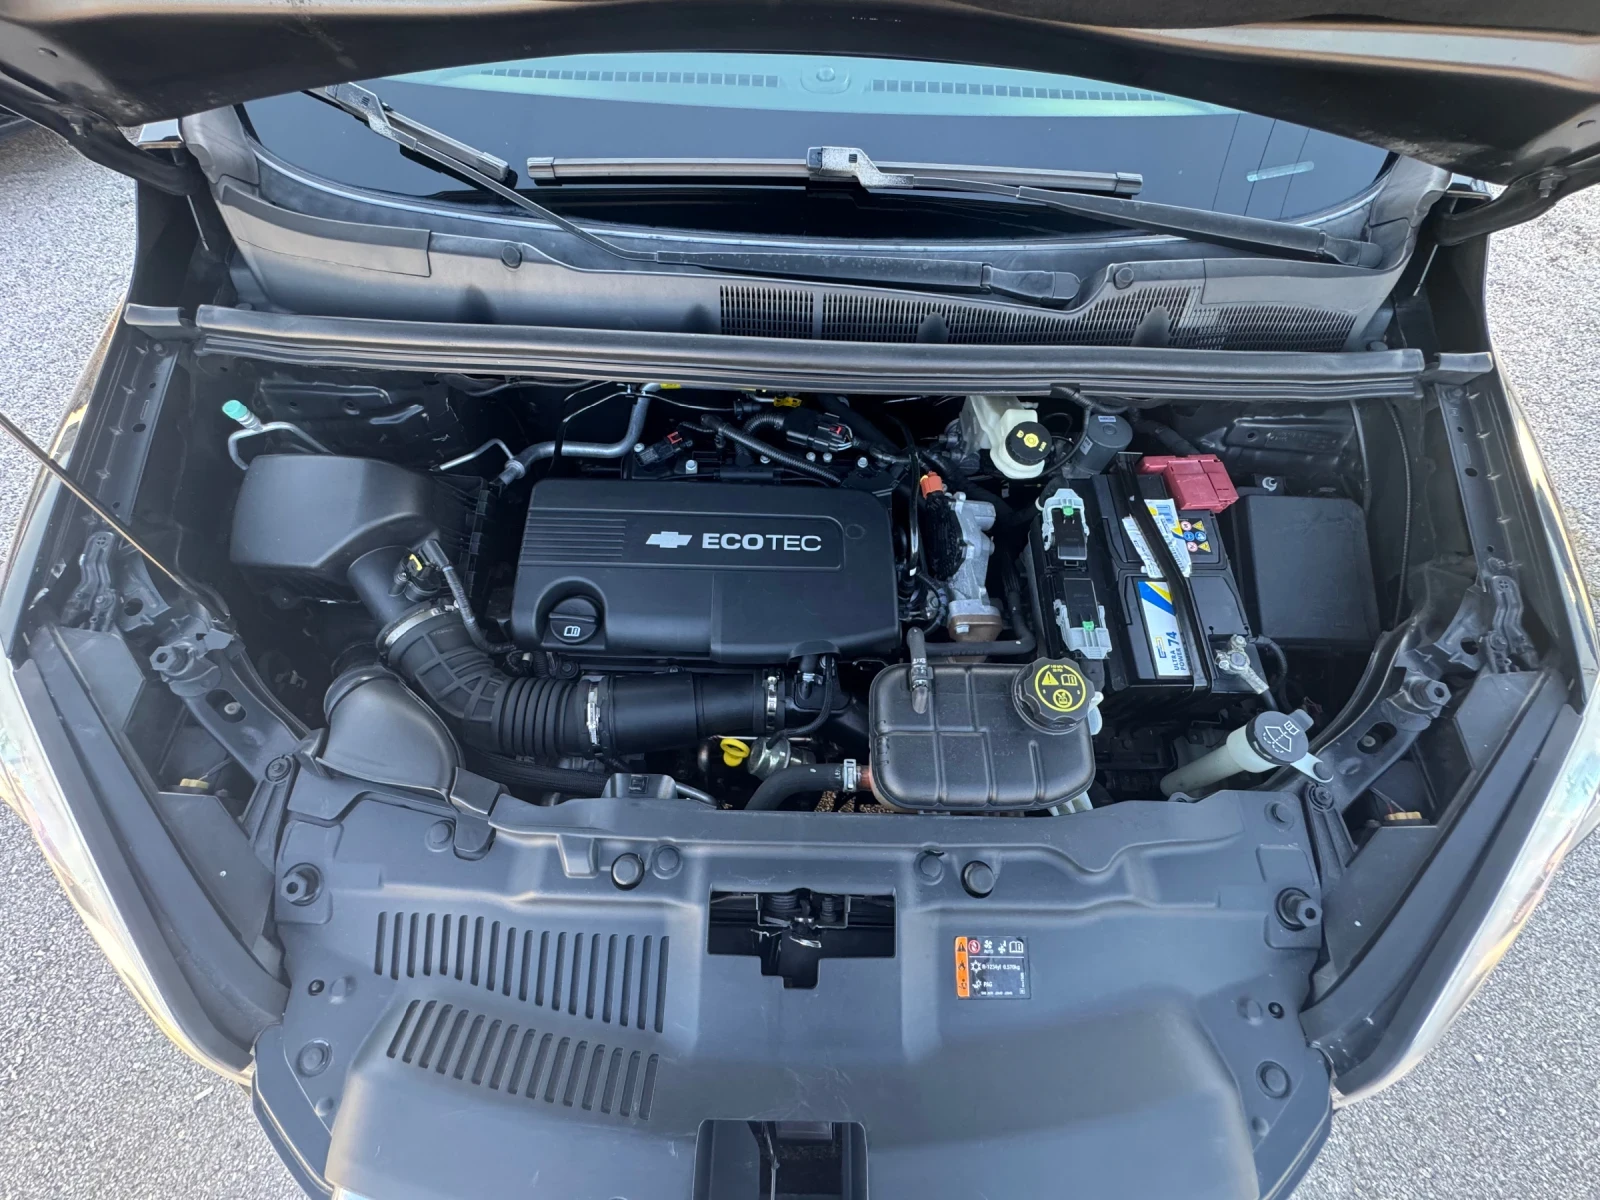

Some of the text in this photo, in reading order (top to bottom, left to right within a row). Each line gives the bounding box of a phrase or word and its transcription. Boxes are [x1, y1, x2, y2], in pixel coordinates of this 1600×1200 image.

[702, 532, 822, 552] ECOTEC
[1166, 631, 1180, 647] 74
[1170, 650, 1180, 671] ULTRA
[1176, 647, 1186, 671] POWER
